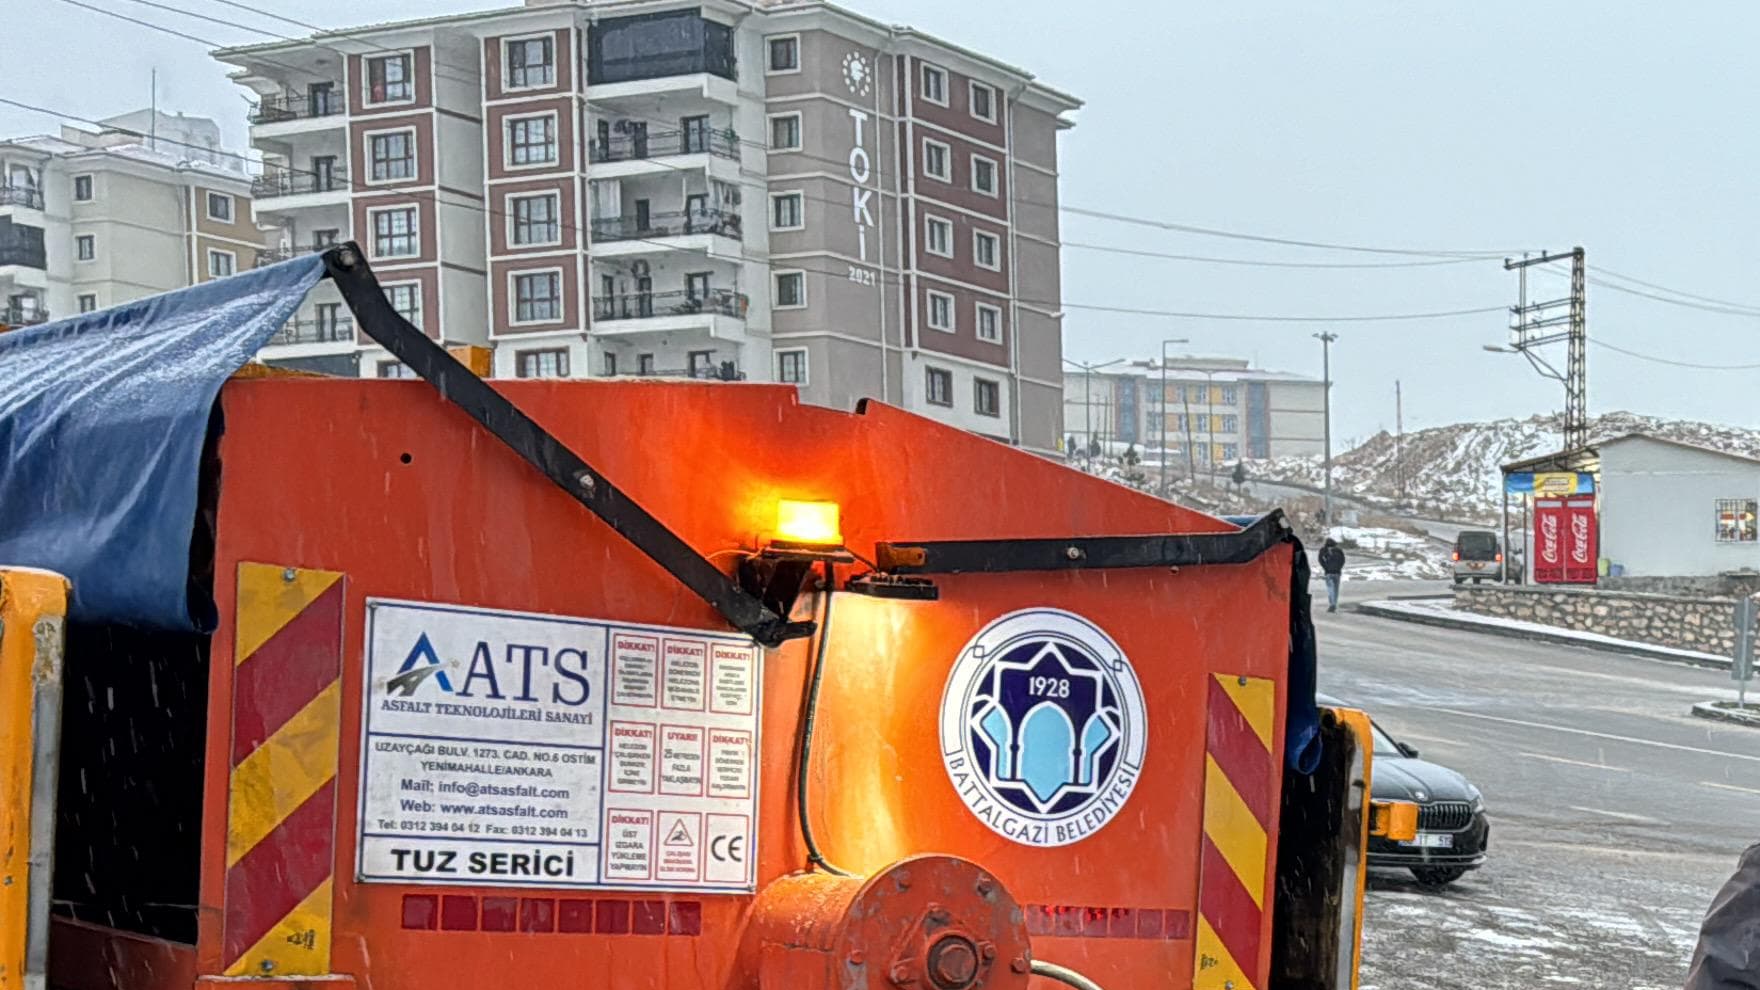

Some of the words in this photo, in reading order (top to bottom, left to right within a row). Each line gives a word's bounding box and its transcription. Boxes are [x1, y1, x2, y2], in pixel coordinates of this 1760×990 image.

[848, 266, 875, 287] 2021
[1542, 513, 1557, 563] Coca-Cola
[1572, 513, 1587, 563] Coca-Cola
[455, 641, 591, 706] ATS
[1029, 676, 1069, 698] 1928
[381, 699, 433, 713] ASFALT
[435, 703, 542, 722] TEKNOLOJİLERİ
[545, 711, 593, 725] SANAYİ
[561, 752, 596, 764] OSTİM
[438, 781, 570, 799] info@atsasfalt.com
[949, 757, 1048, 844] BATTALGAZİ
[1057, 767, 1136, 843] BELEDİYESİ
[400, 799, 435, 812] Web:
[440, 804, 568, 818] www.atsasfalt.com
[390, 849, 457, 873] TUZ
[468, 849, 574, 877] SERİCİ
